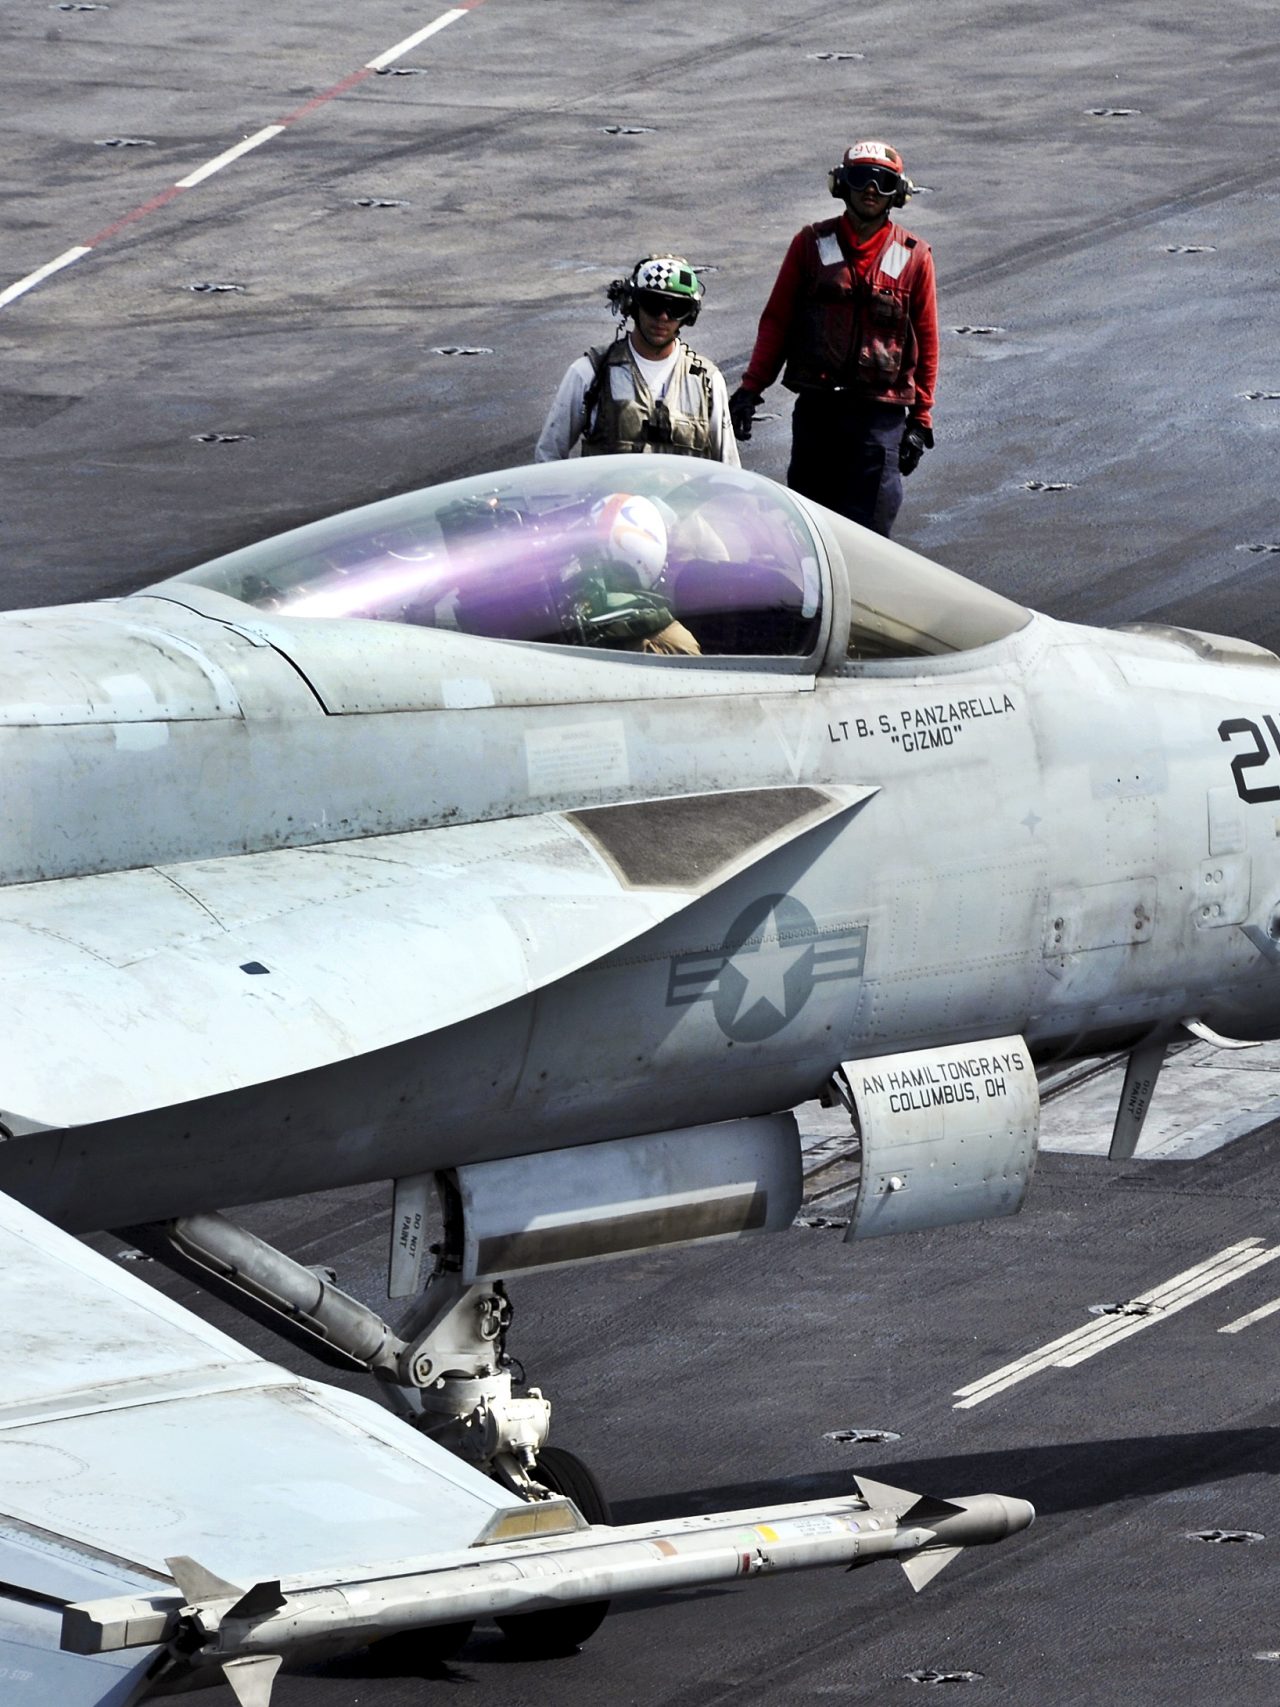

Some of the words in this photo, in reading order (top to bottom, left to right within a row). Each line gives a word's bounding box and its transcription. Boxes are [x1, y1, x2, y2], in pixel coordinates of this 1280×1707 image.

[828, 722, 849, 742] LT
[857, 719, 874, 738] B.
[879, 715, 897, 733] S.
[900, 694, 1015, 730] PANZARELLA
[891, 725, 962, 753] "GIZMO"
[863, 1074, 885, 1095] AN
[889, 1082, 980, 1113] COLUMBUS,
[986, 1077, 1006, 1098] OH
[1127, 1081, 1141, 1114] PAINT
[1142, 1080, 1150, 1095] DO
[1135, 1100, 1145, 1121] NOT
[399, 1216, 411, 1248] PAINT
[414, 1213, 421, 1230] DO
[409, 1235, 418, 1259] NOT
